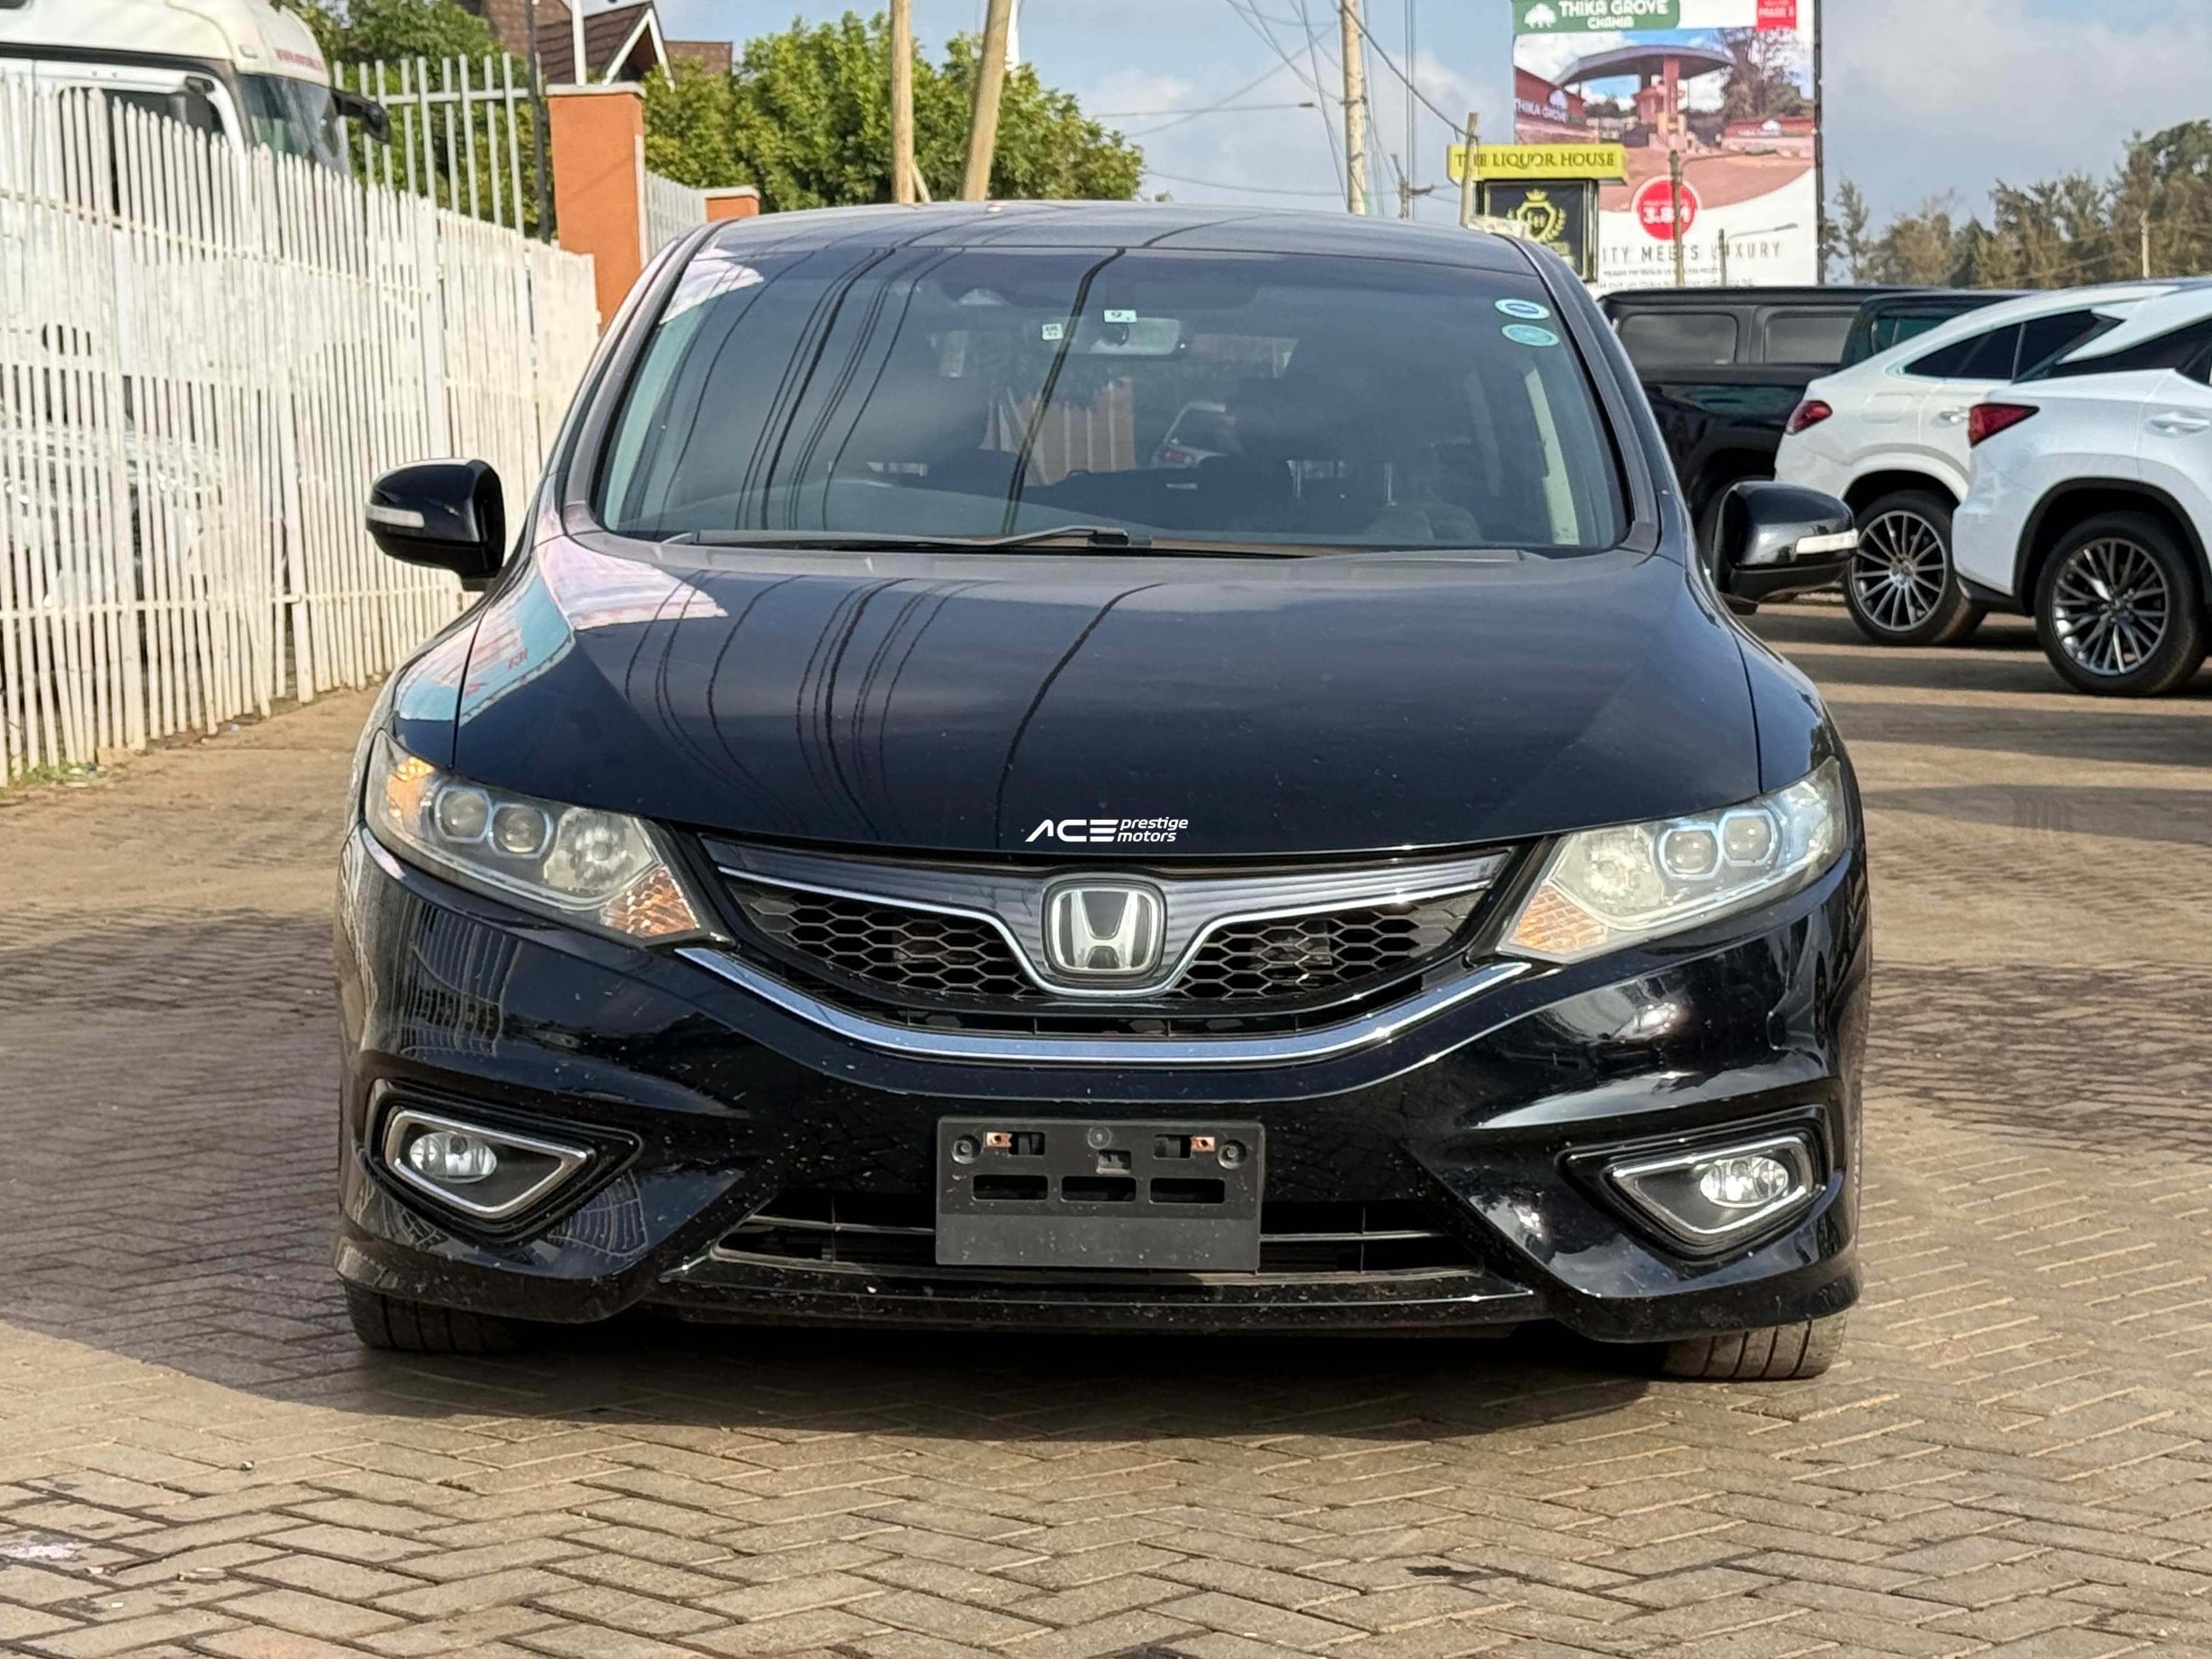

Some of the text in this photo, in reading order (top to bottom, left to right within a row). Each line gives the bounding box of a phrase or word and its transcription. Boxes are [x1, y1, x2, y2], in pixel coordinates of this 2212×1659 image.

[1558, 0, 1669, 17] THIKA GROVE
[1587, 16, 1634, 29] CHANIA
[1493, 153, 1557, 169] LIQUOR
[1560, 153, 1614, 166] HOUSE
[1642, 245, 1699, 262] MEES
